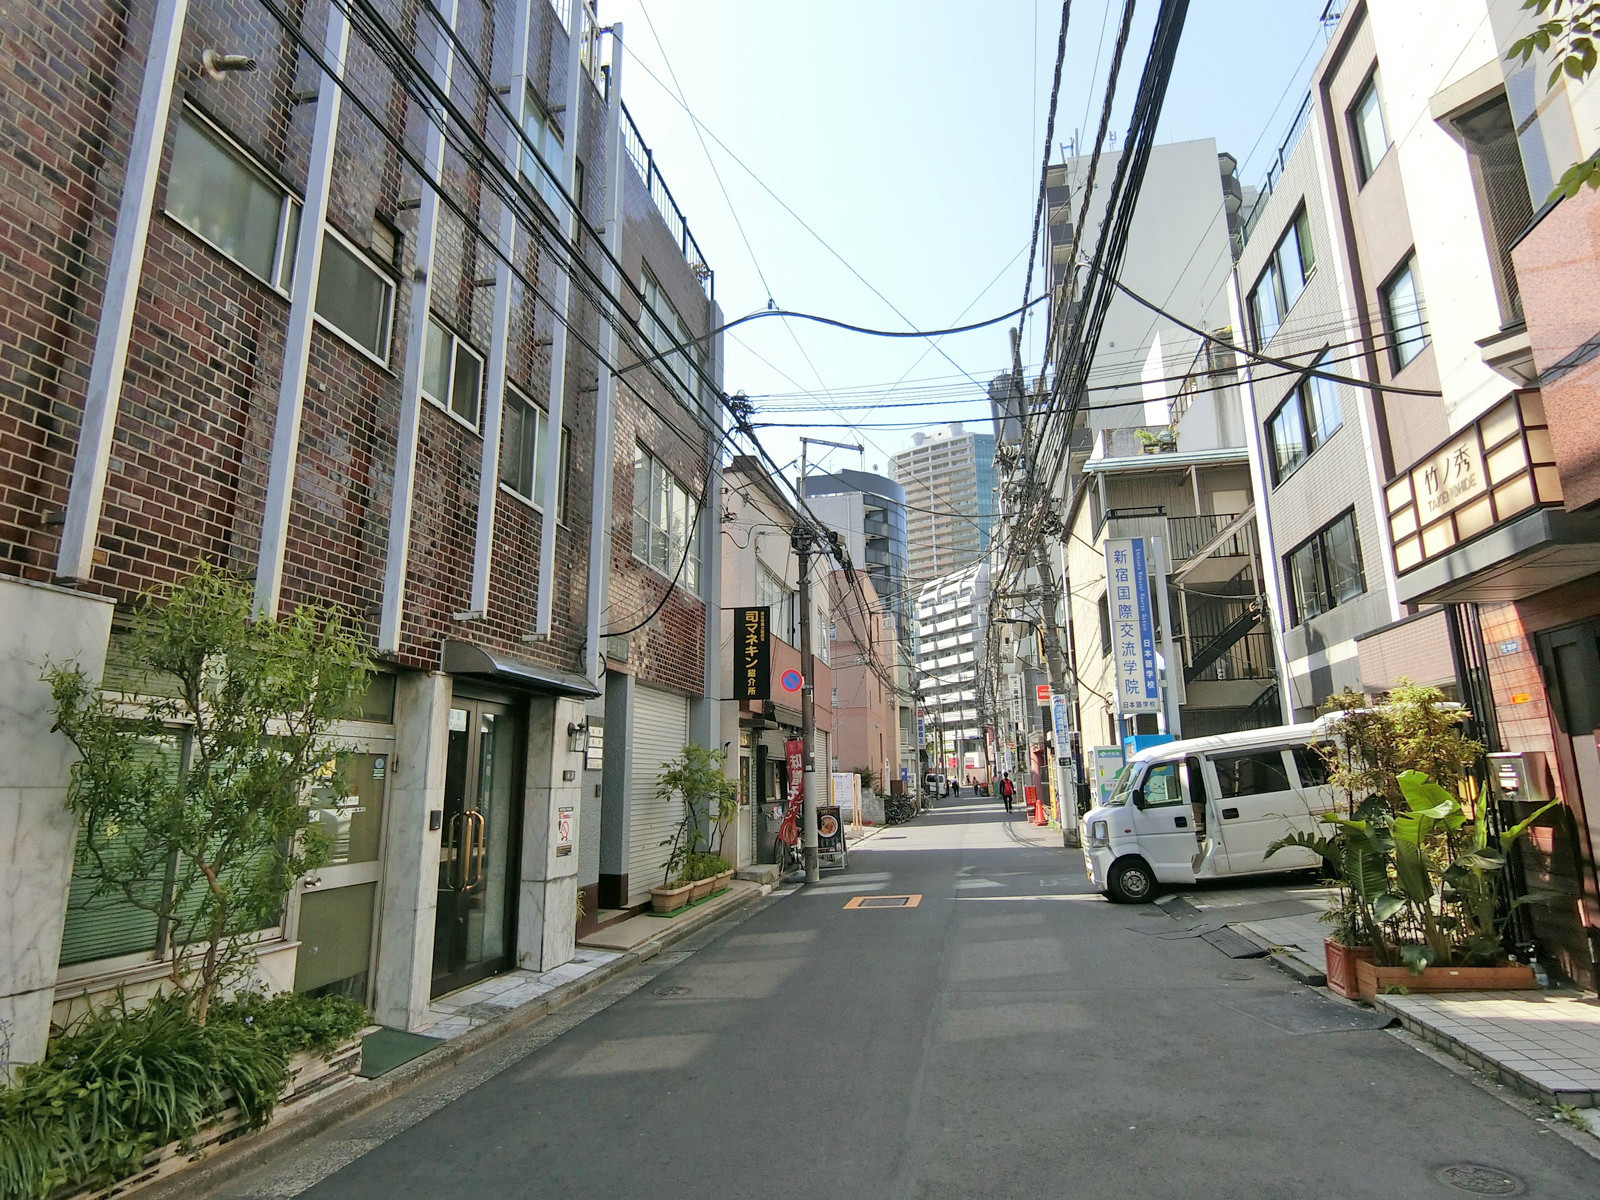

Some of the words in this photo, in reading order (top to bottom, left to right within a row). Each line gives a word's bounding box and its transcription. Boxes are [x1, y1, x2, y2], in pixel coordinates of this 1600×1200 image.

[1425, 443, 1471, 495] 竹ノ秀
[1427, 473, 1478, 512] TAKENOHIDE
[1113, 549, 1140, 695] 新宿国際交流学院
[745, 610, 759, 696] 司マネキン紹介所
[1143, 639, 1155, 689] 日本語学校
[1123, 701, 1156, 709] 日本語学校
